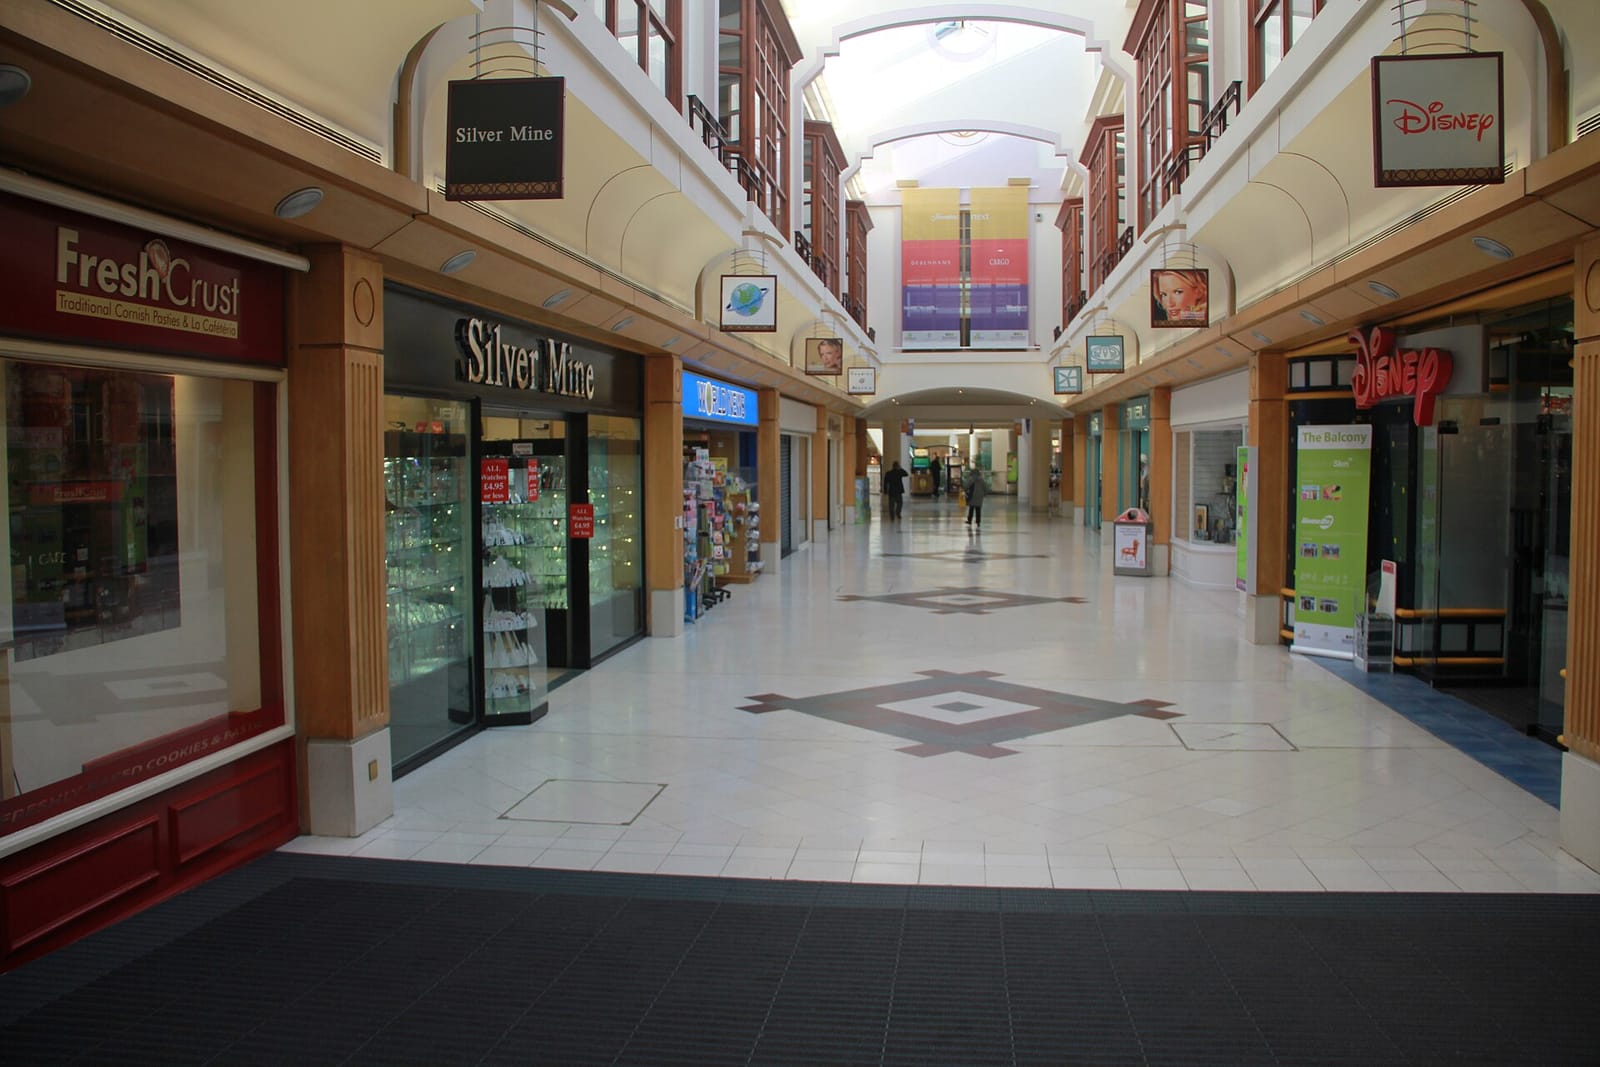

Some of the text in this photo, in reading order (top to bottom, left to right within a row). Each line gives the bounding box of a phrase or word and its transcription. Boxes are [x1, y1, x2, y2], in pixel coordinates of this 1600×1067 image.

[455, 126, 553, 143] Silver Mine
[59, 294, 112, 316] Traditional
[115, 303, 150, 322] Cornish
[153, 310, 180, 328] Pasties
[183, 315, 189, 328] &
[466, 318, 595, 400] Silver Mine
[1303, 431, 1367, 445] The Balcony
[484, 482, 504, 490] £4.95
[146, 739, 209, 768] COOKIES
